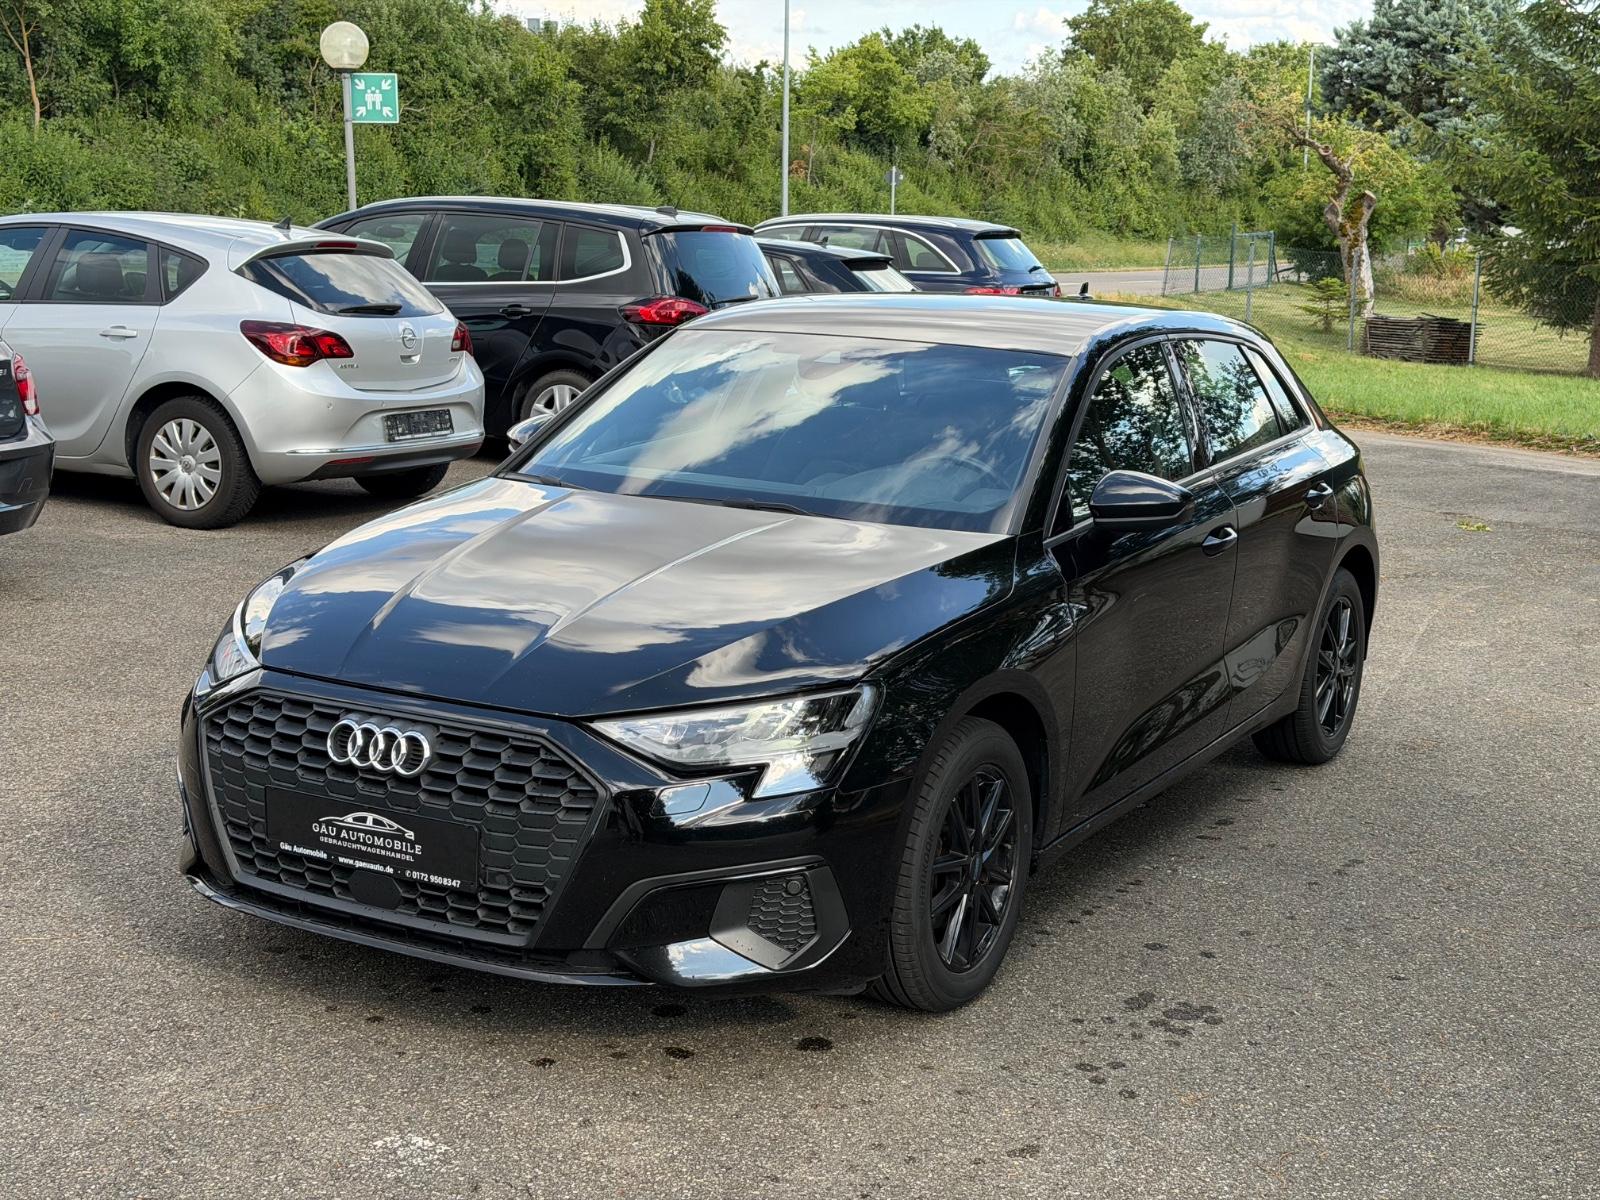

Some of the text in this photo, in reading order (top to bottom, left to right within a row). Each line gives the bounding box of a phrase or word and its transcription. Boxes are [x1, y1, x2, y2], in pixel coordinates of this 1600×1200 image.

[312, 823, 422, 855] GÄU AUTOMOBILE
[319, 836, 415, 862] GEBRAUCHTWAGENHANDEL
[293, 844, 328, 860] Automobile
[412, 871, 429, 882] 0172
